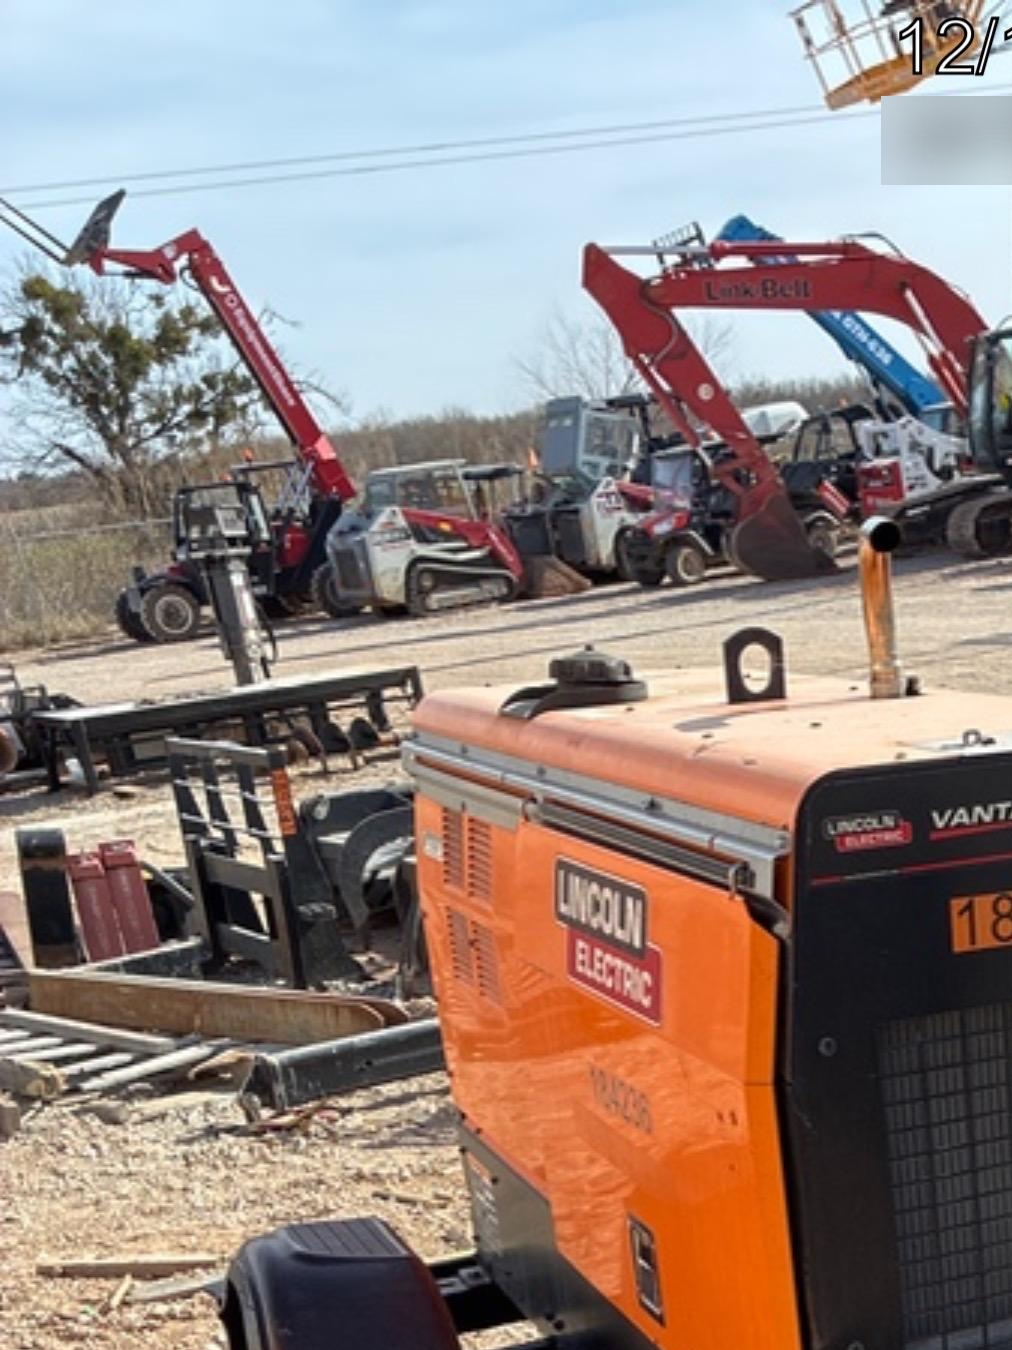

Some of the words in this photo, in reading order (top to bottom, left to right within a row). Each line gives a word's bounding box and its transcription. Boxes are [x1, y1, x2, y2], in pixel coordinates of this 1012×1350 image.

[827, 815, 895, 835] LINCOLN
[558, 869, 643, 949] LINCOLN
[575, 938, 652, 1008] ELECTRIC
